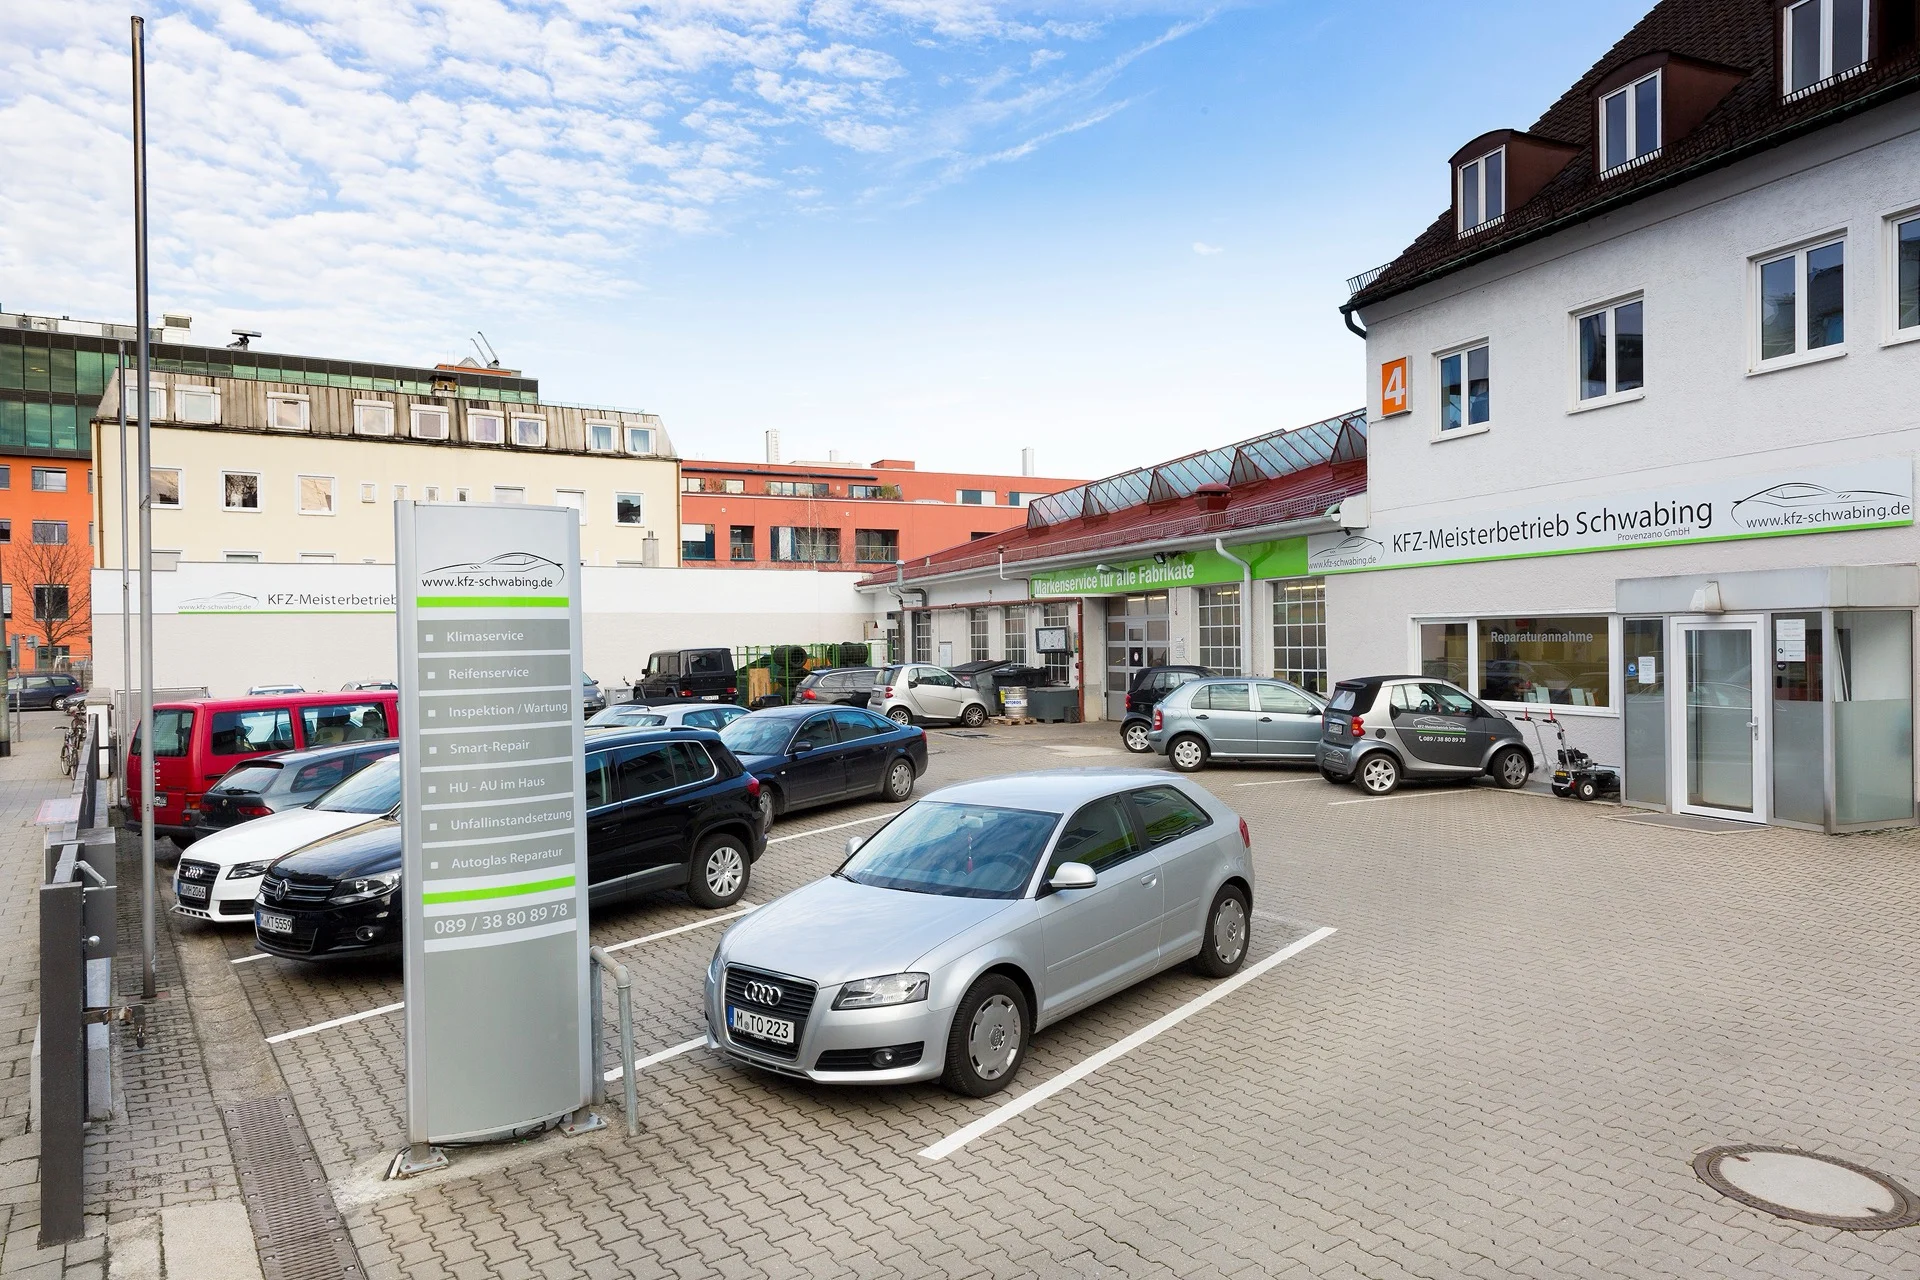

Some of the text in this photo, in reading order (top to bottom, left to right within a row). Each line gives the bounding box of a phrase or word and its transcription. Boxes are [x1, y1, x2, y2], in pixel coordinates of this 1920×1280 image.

[1384, 366, 1406, 406] 4
[1746, 502, 1911, 529] www.kfz-schwabing.de
[1393, 500, 1713, 553] KFZ-Meisterbetrieb Schwabing
[1617, 526, 1690, 542] Provenzano GmbH
[1308, 554, 1377, 570] www.kfz-schwabing.de
[422, 575, 553, 590] www.kfz-schwabing.de
[1034, 572, 1098, 595] Markenservice
[1116, 567, 1136, 586] alle
[1139, 561, 1195, 584] Fabrikate
[178, 603, 252, 611] www.kfz-schwabing.de
[446, 631, 524, 643] Klimaservice
[1490, 630, 1594, 645] Reparaturannahme
[448, 668, 530, 681] Reifenservice
[449, 702, 569, 720] Inspektion / Wartung
[450, 739, 531, 755] Smart-Repair
[449, 782, 469, 794] HU
[479, 780, 498, 792] AU
[500, 780, 516, 790] im
[518, 777, 546, 789] Haus
[451, 810, 572, 830] Unfallinstandsetzung
[451, 847, 563, 870] Autoglas Reparatur
[275, 917, 291, 931] 5559
[434, 903, 569, 934] 089 / 38 80 89 78
[736, 1010, 743, 1028] M
[750, 1014, 763, 1034] TO
[766, 1019, 789, 1039] 223
